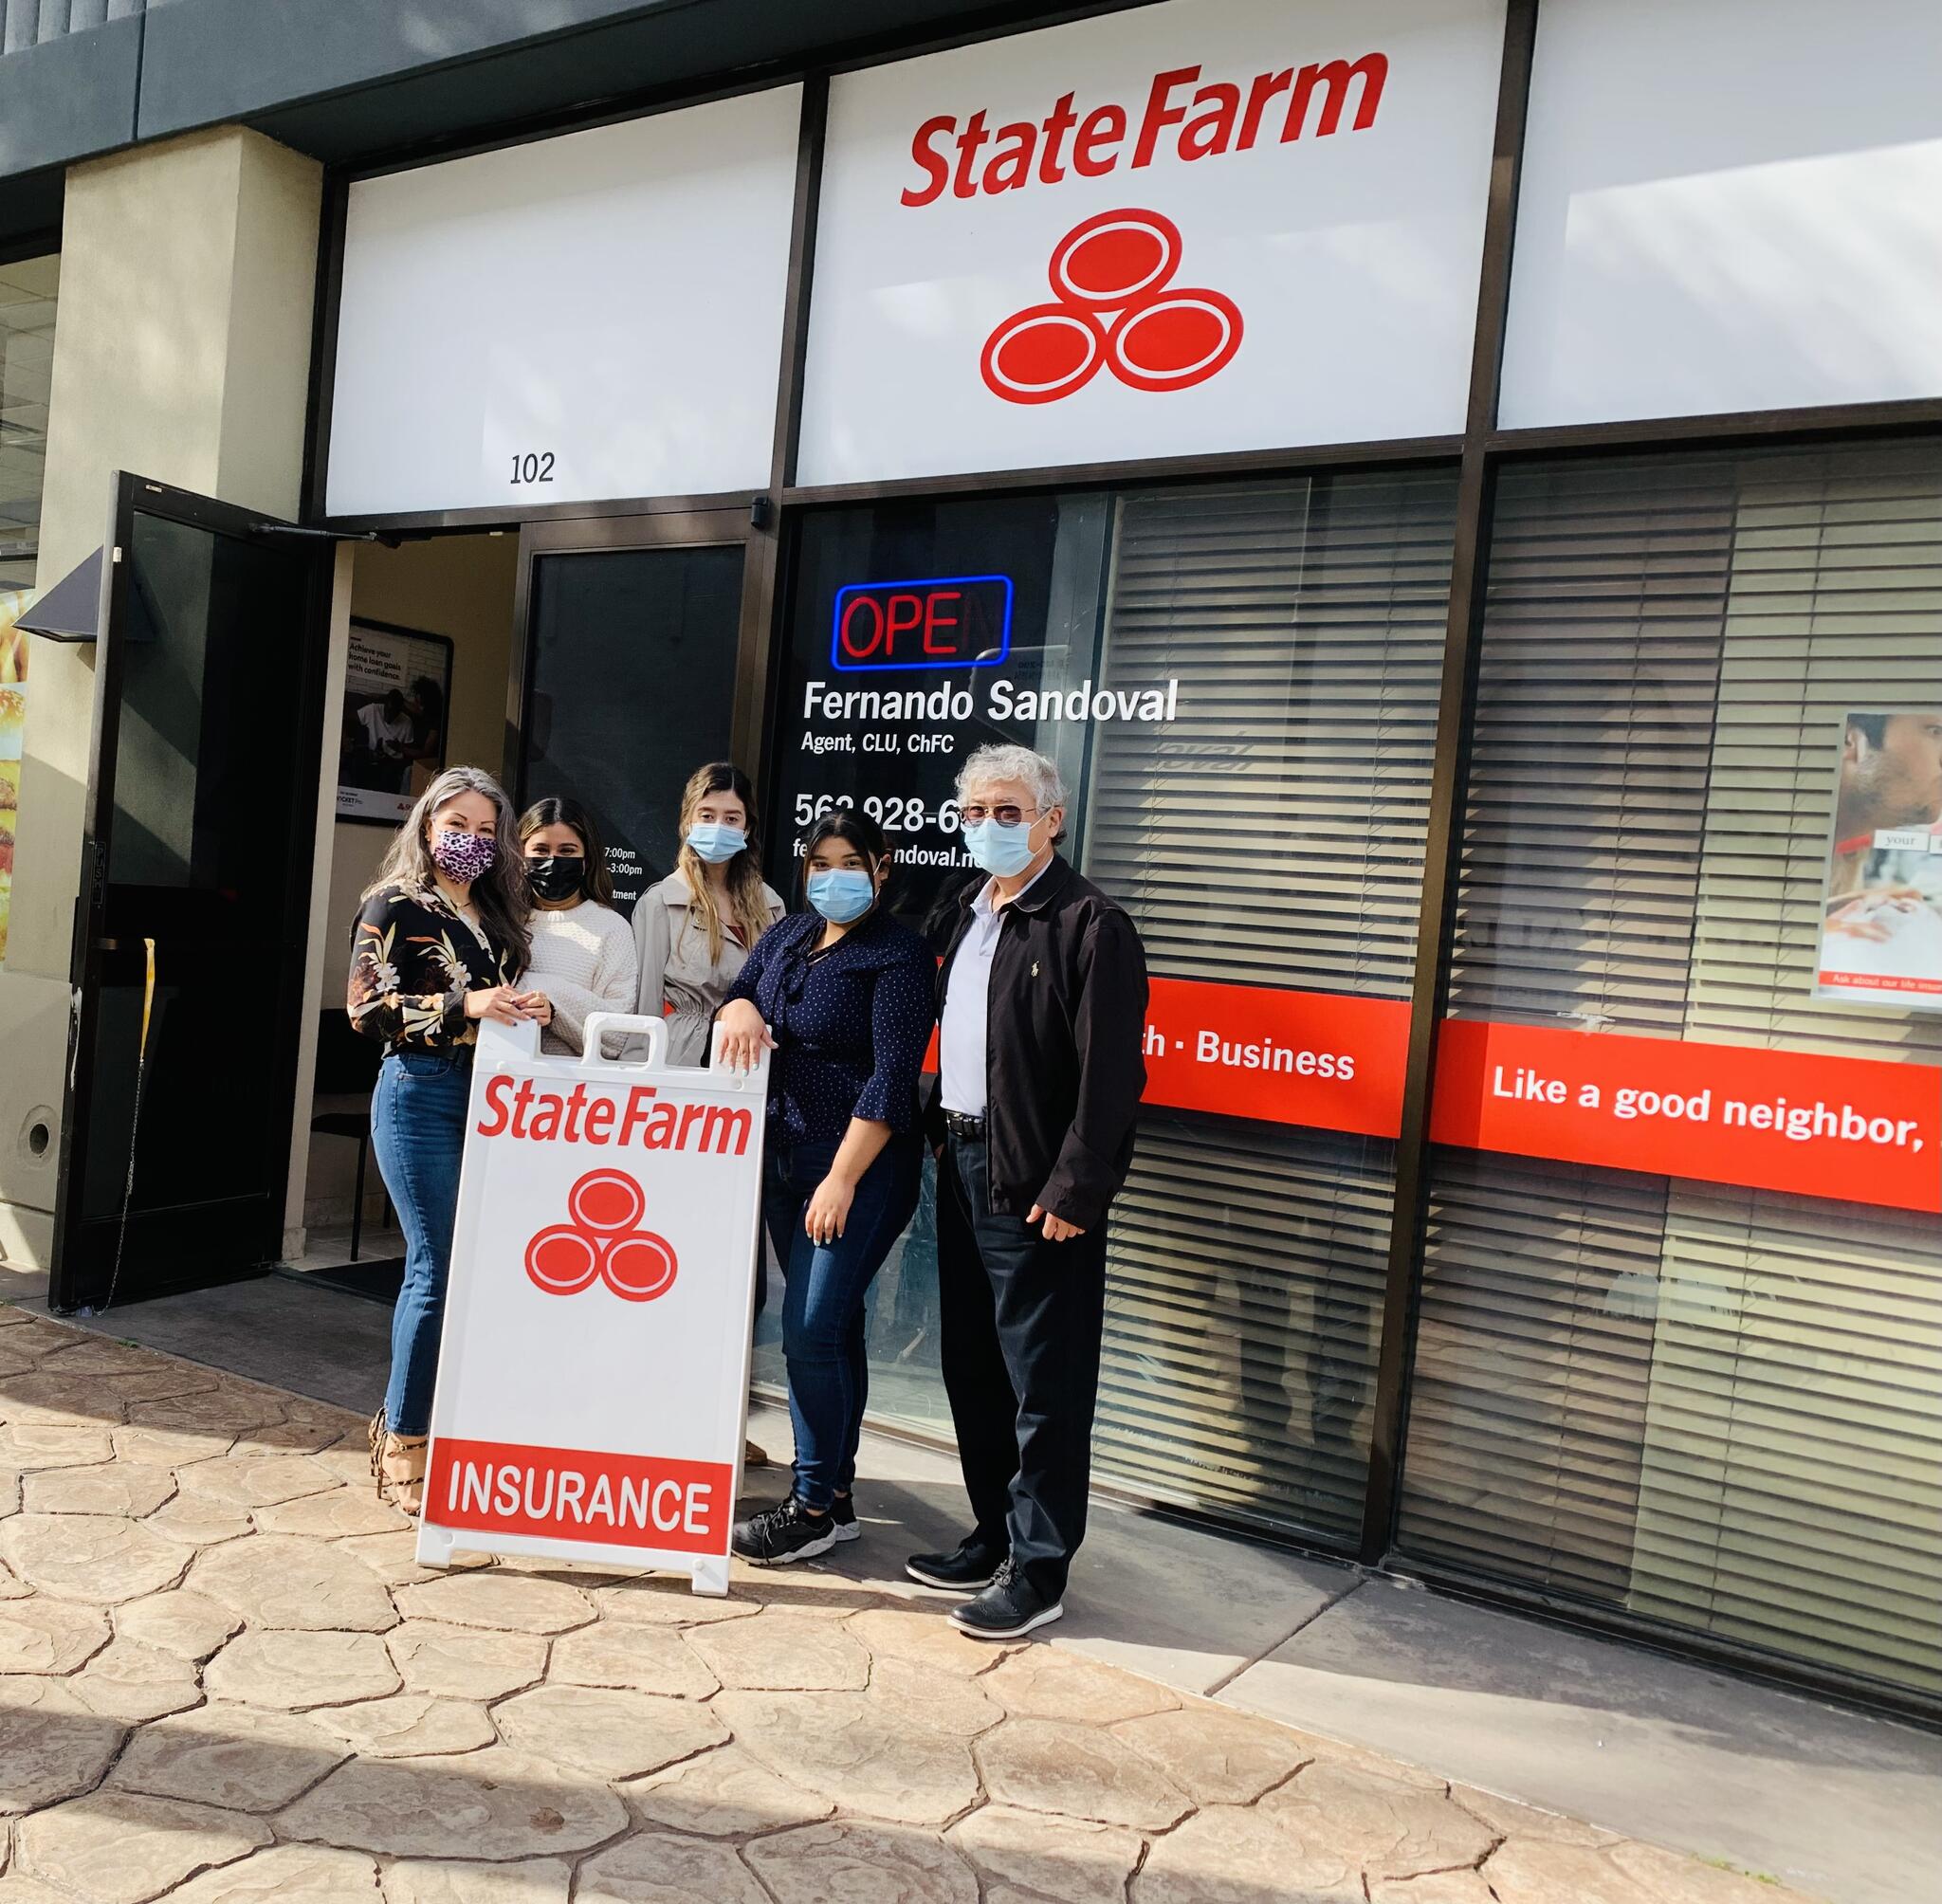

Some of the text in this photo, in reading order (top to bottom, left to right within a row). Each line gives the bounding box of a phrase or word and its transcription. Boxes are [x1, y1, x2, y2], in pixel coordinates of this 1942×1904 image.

[510, 452, 555, 484] 102
[348, 651, 401, 671] home loan goals
[349, 643, 392, 659] Achieve your
[348, 663, 363, 672] with
[803, 679, 1179, 722] Fernando Sandoval
[800, 731, 955, 755] Agent, CLU, ChFC
[864, 796, 961, 833] 928-6
[1885, 835, 1916, 847] your
[1853, 976, 1879, 987] about
[1882, 979, 1899, 988] our
[1197, 1030, 1355, 1081] Business
[1493, 1065, 1924, 1153] Like a good neighbor,
[448, 1460, 712, 1535] INSURANCE
